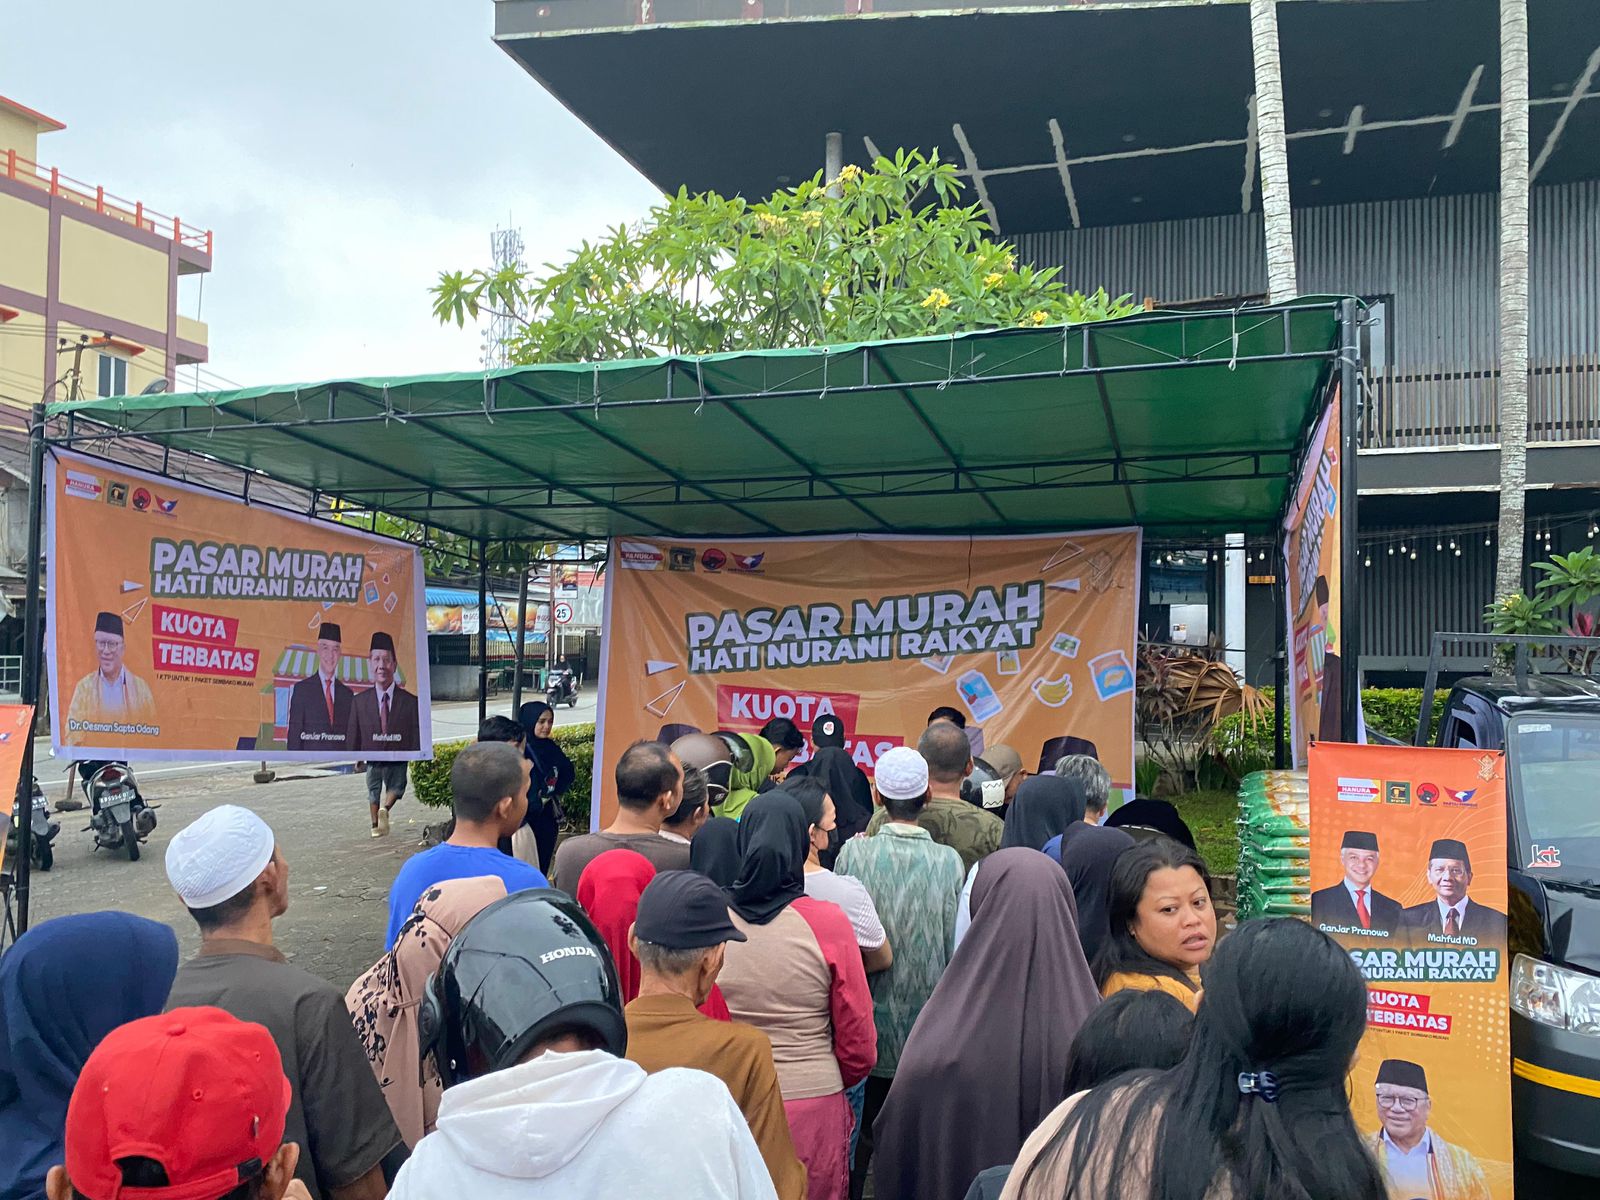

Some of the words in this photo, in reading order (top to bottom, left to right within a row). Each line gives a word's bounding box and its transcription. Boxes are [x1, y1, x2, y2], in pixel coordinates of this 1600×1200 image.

[154, 542, 260, 575] PASAR
[267, 551, 363, 581] MURAH
[154, 573, 206, 594] HATI
[212, 576, 287, 597] NURANI
[293, 580, 359, 598] RAKYAT
[556, 608, 567, 619] 25
[689, 606, 840, 647] PASAR
[855, 583, 1041, 635] MURAH
[161, 611, 227, 640] KUOTA
[691, 646, 758, 671] HATI
[767, 635, 891, 667] NURANI
[900, 621, 1038, 656] RAKYAT
[159, 643, 255, 672] TERBATAS
[731, 692, 836, 722] KUOTA
[70, 720, 81, 730] Dr.
[82, 721, 112, 732] Oesman
[113, 723, 135, 734] Sapta
[136, 724, 159, 735] Odang
[1351, 926, 1389, 937] Pranowo
[1427, 933, 1461, 944] Mahfud
[1462, 937, 1478, 946] MD
[539, 946, 597, 965] HONDA
[1350, 950, 1398, 968] SAR
[1404, 951, 1497, 968] MURAH
[1428, 967, 1496, 979] RAKYAT
